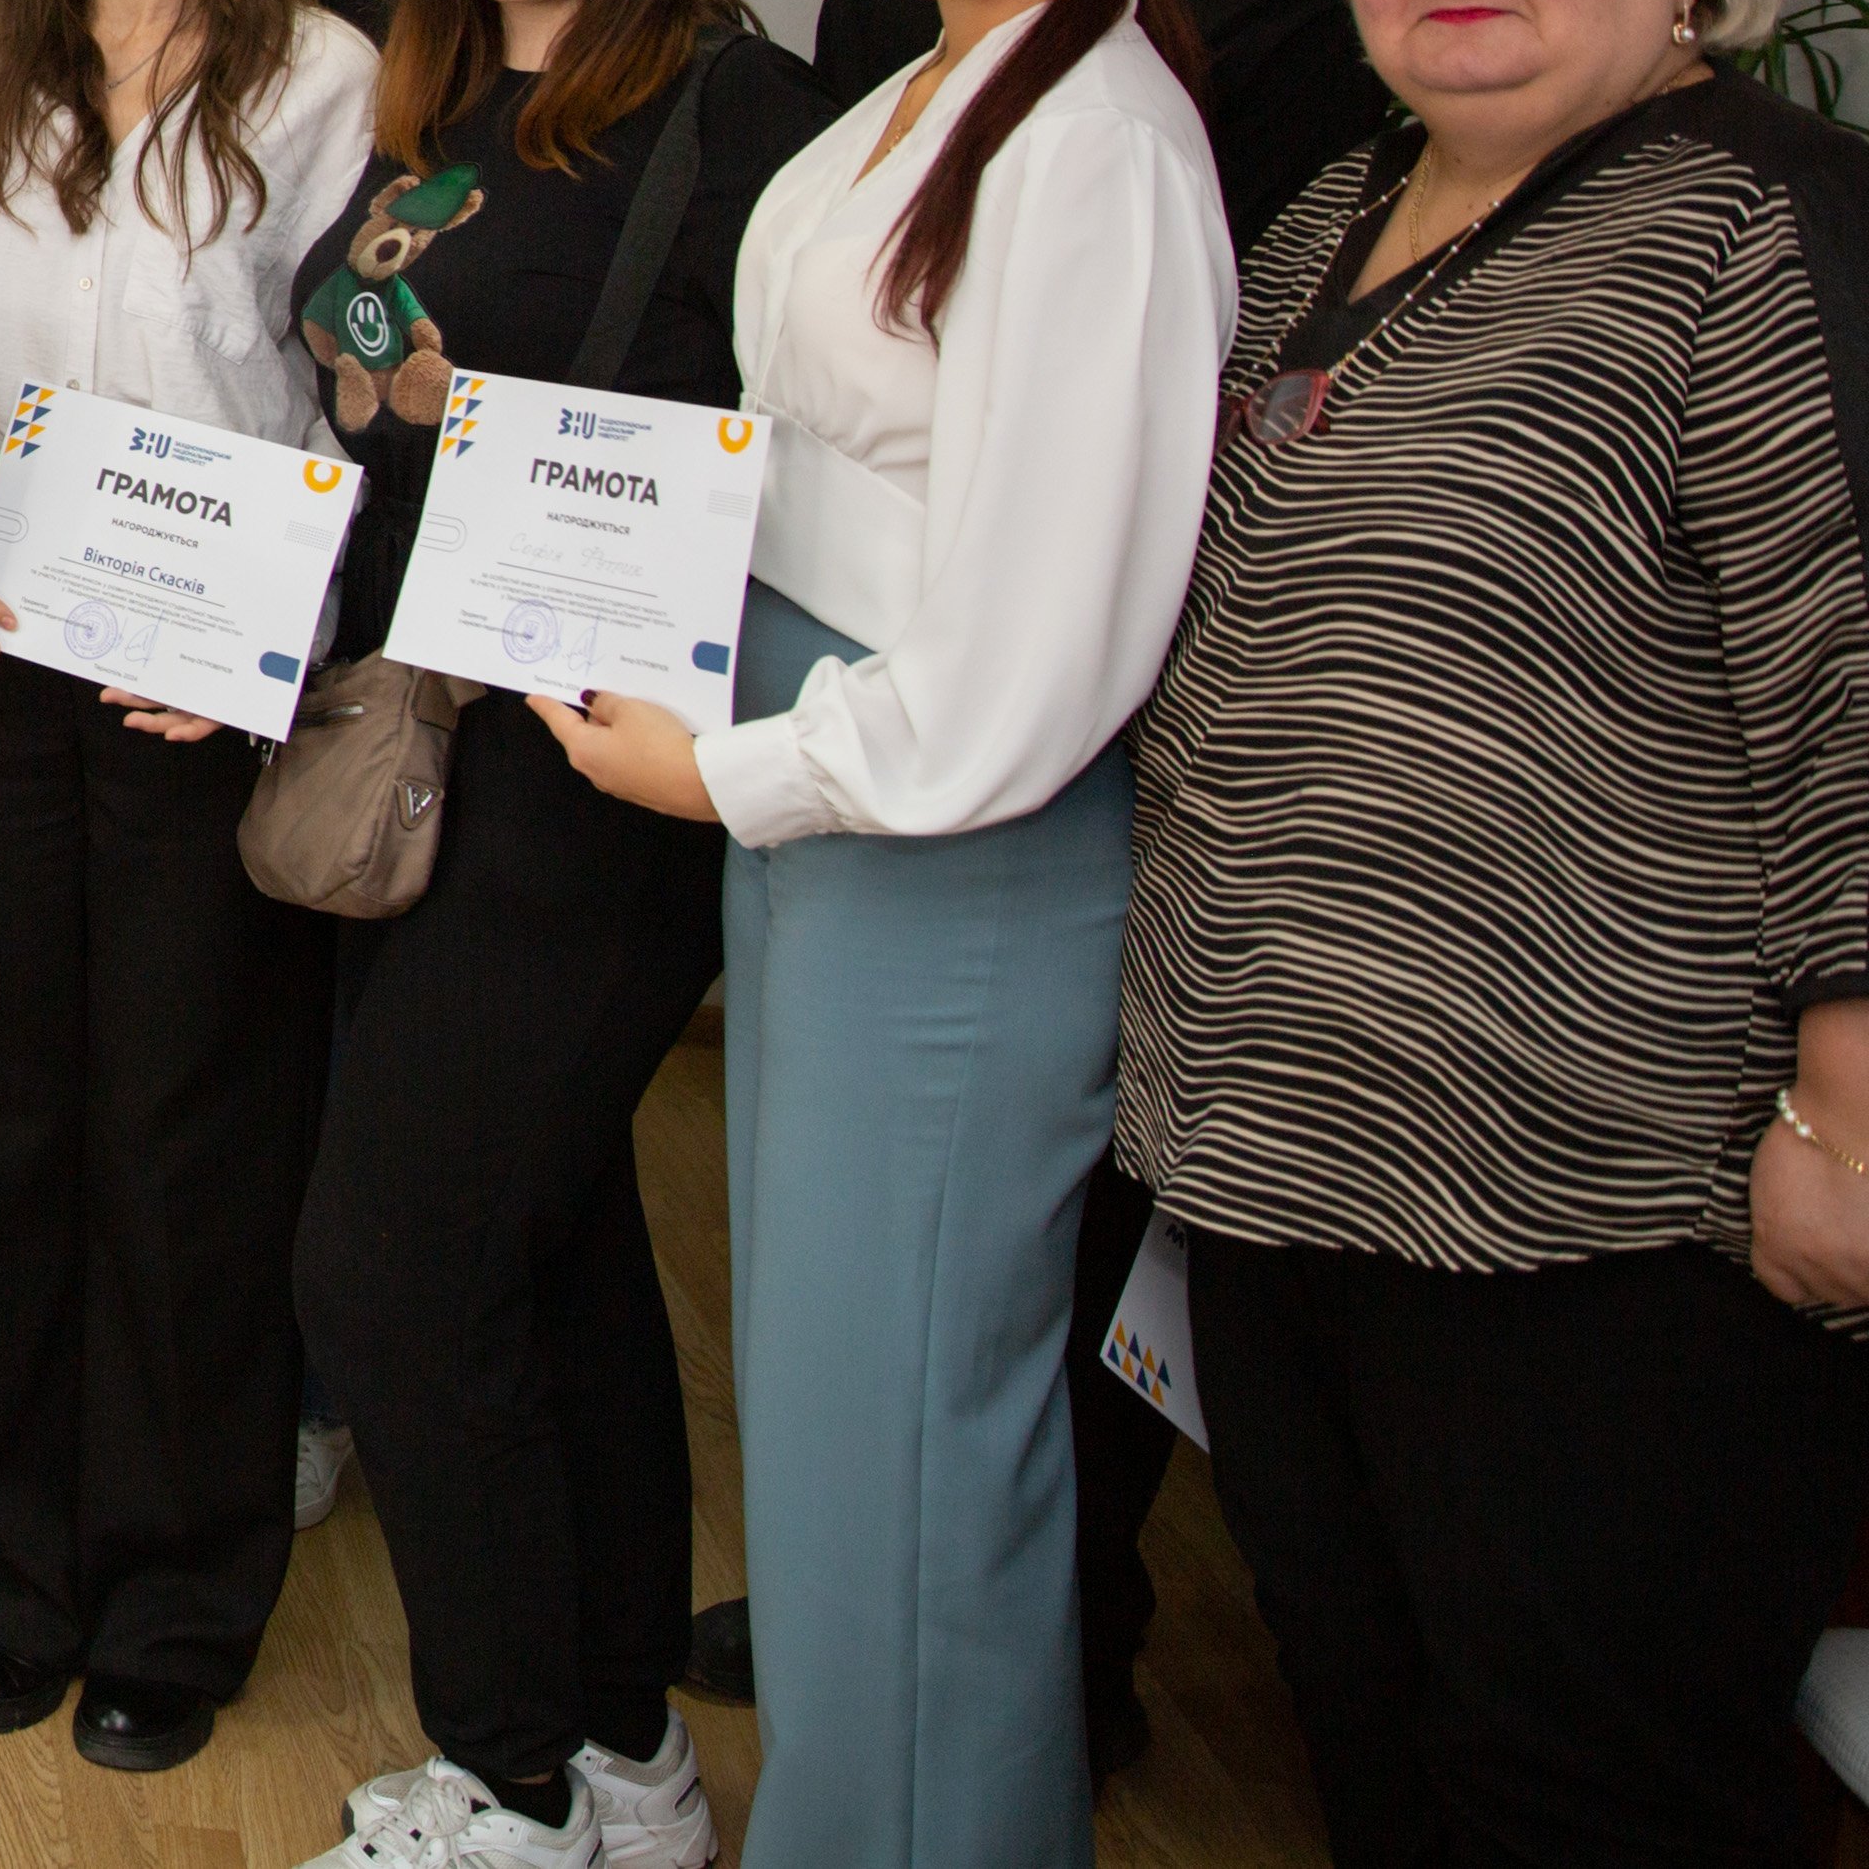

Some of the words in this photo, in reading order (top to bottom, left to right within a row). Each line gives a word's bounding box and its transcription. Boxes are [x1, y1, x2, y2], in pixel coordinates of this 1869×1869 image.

[96, 468, 231, 526] ГРАМОТА
[530, 458, 658, 505] ГРАМОТА
[80, 546, 145, 576] Вікторія
[148, 566, 205, 594] Скасків
